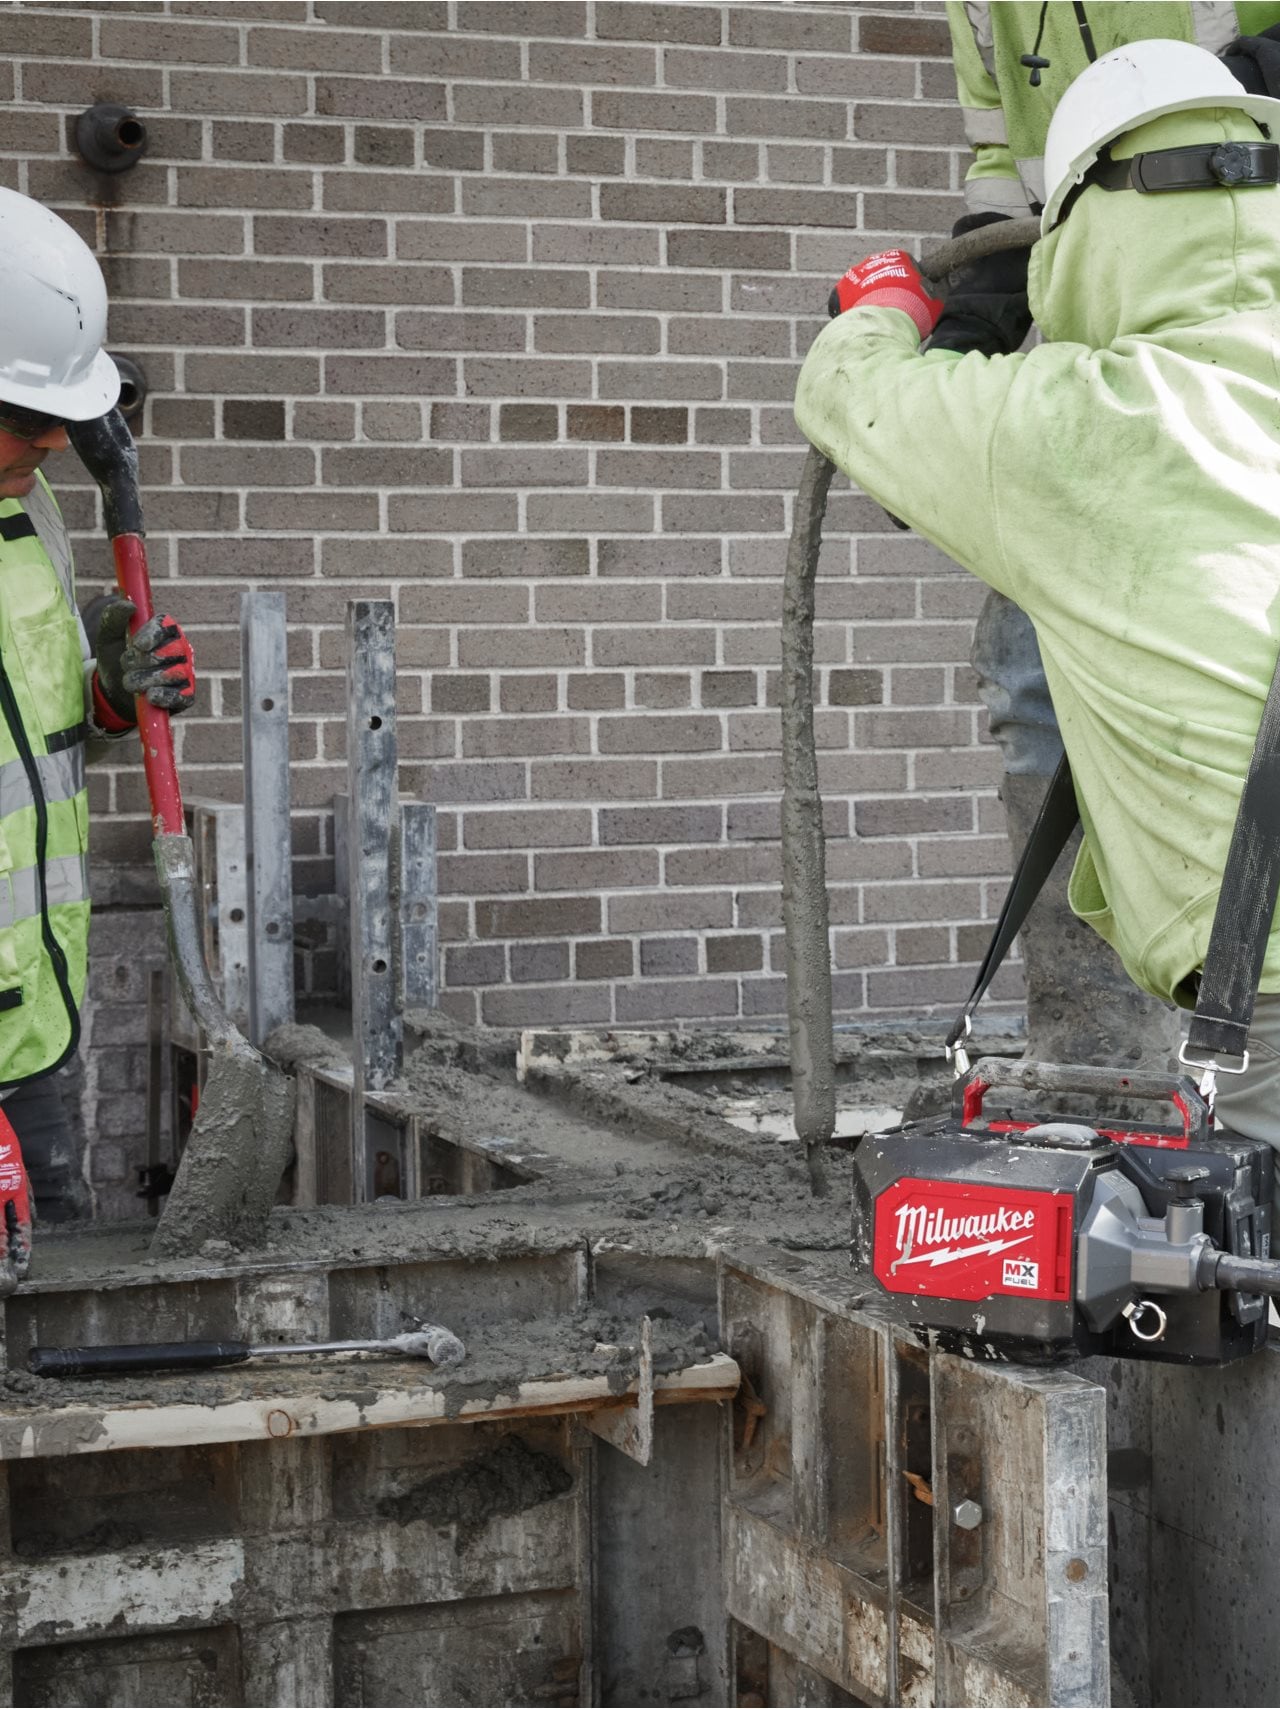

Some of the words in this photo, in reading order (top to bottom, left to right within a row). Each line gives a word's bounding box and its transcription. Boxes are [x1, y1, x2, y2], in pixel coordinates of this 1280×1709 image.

[895, 1203, 1035, 1251] Milwaukee
[1005, 1263, 1035, 1278] MX
[1004, 1276, 1036, 1287] FUEL
